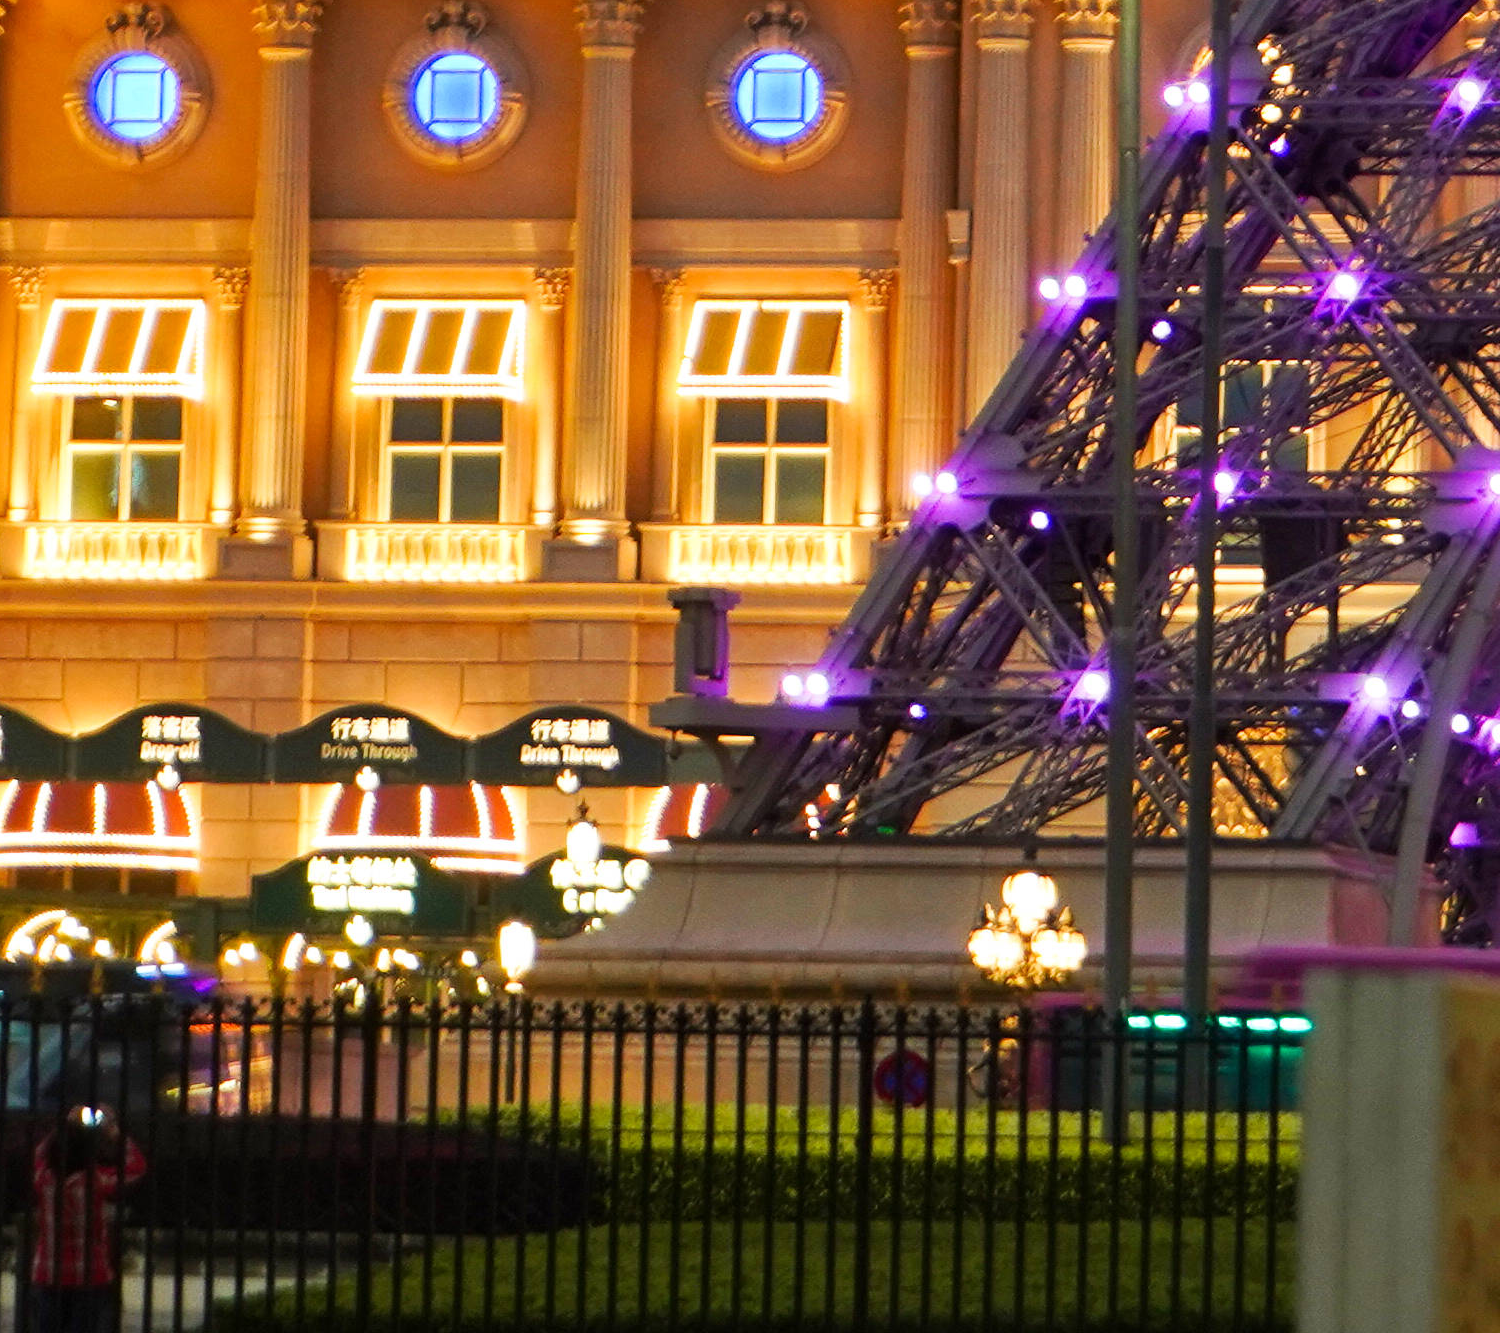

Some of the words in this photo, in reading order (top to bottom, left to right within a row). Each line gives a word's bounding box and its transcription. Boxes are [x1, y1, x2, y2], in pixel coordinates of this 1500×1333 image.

[331, 717, 411, 742] 行车通道
[531, 718, 611, 743] 行车通道
[321, 742, 359, 760] Drive
[362, 742, 419, 762] Through
[520, 743, 560, 765] Drive
[560, 743, 620, 771] Through
